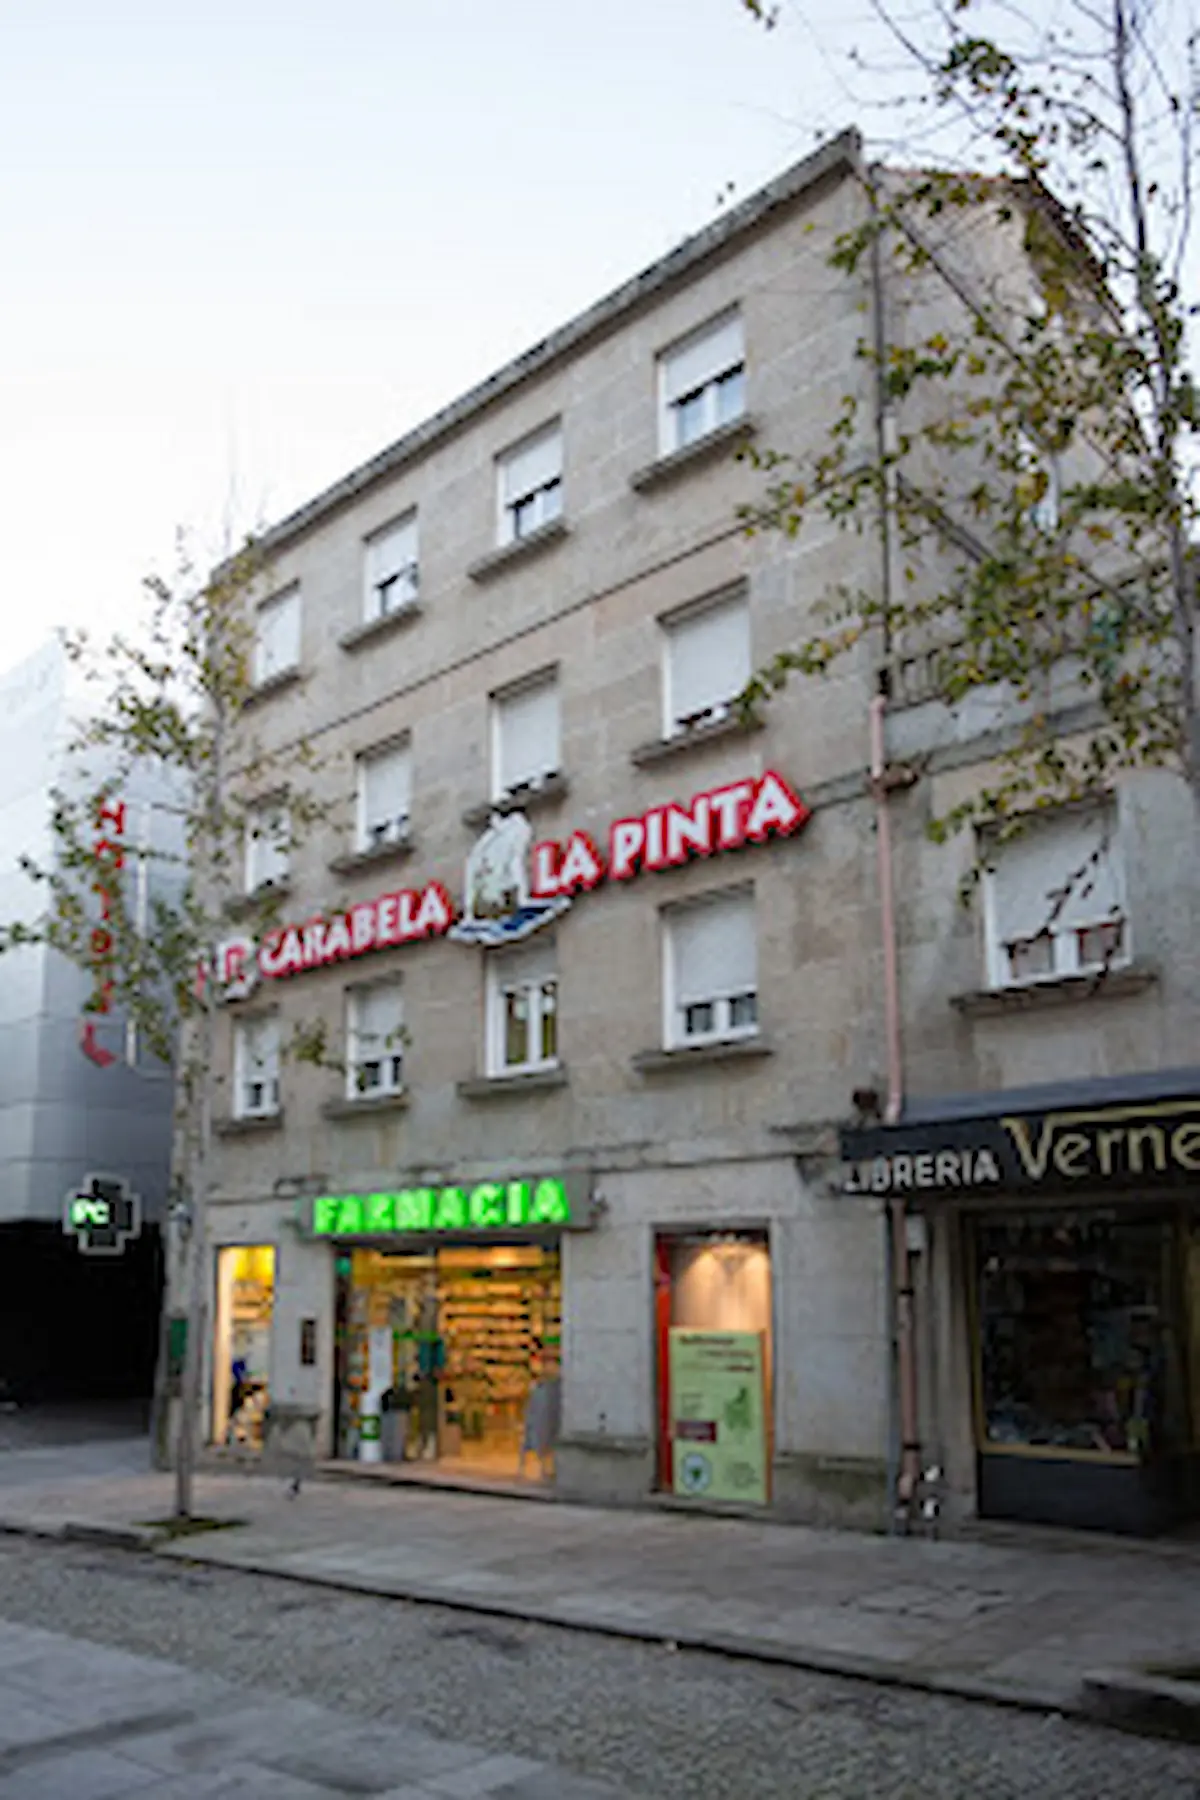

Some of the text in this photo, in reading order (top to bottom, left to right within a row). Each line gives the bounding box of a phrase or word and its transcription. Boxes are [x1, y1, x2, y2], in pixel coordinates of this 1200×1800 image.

[259, 881, 454, 978] CARABELA
[531, 830, 604, 889] LA
[609, 770, 807, 878] PINTA
[845, 1100, 1200, 1193] LIBRERIA Verne
[313, 1178, 570, 1234] FARMACIA
